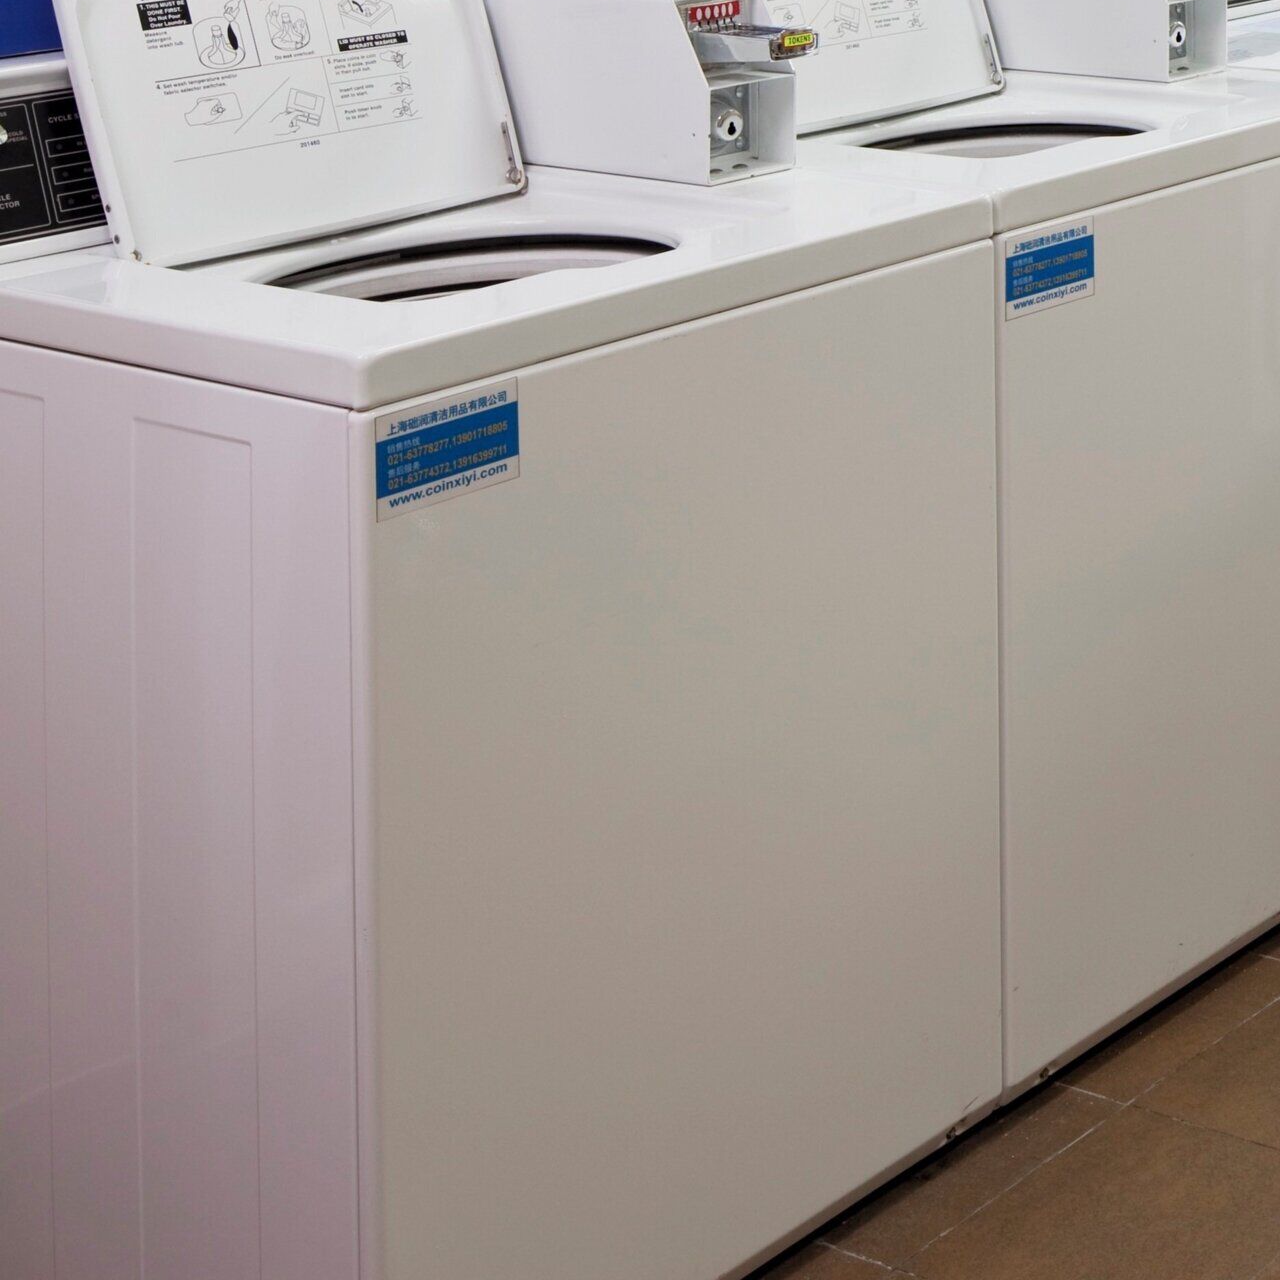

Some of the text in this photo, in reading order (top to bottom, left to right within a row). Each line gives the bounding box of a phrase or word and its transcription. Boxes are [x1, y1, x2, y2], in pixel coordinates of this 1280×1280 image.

[788, 35, 811, 44] TOKENS
[48, 114, 72, 124] CYCLE
[1013, 283, 1087, 310] www.coinxiyi.com
[389, 463, 508, 508] www.coinxiyi.com
